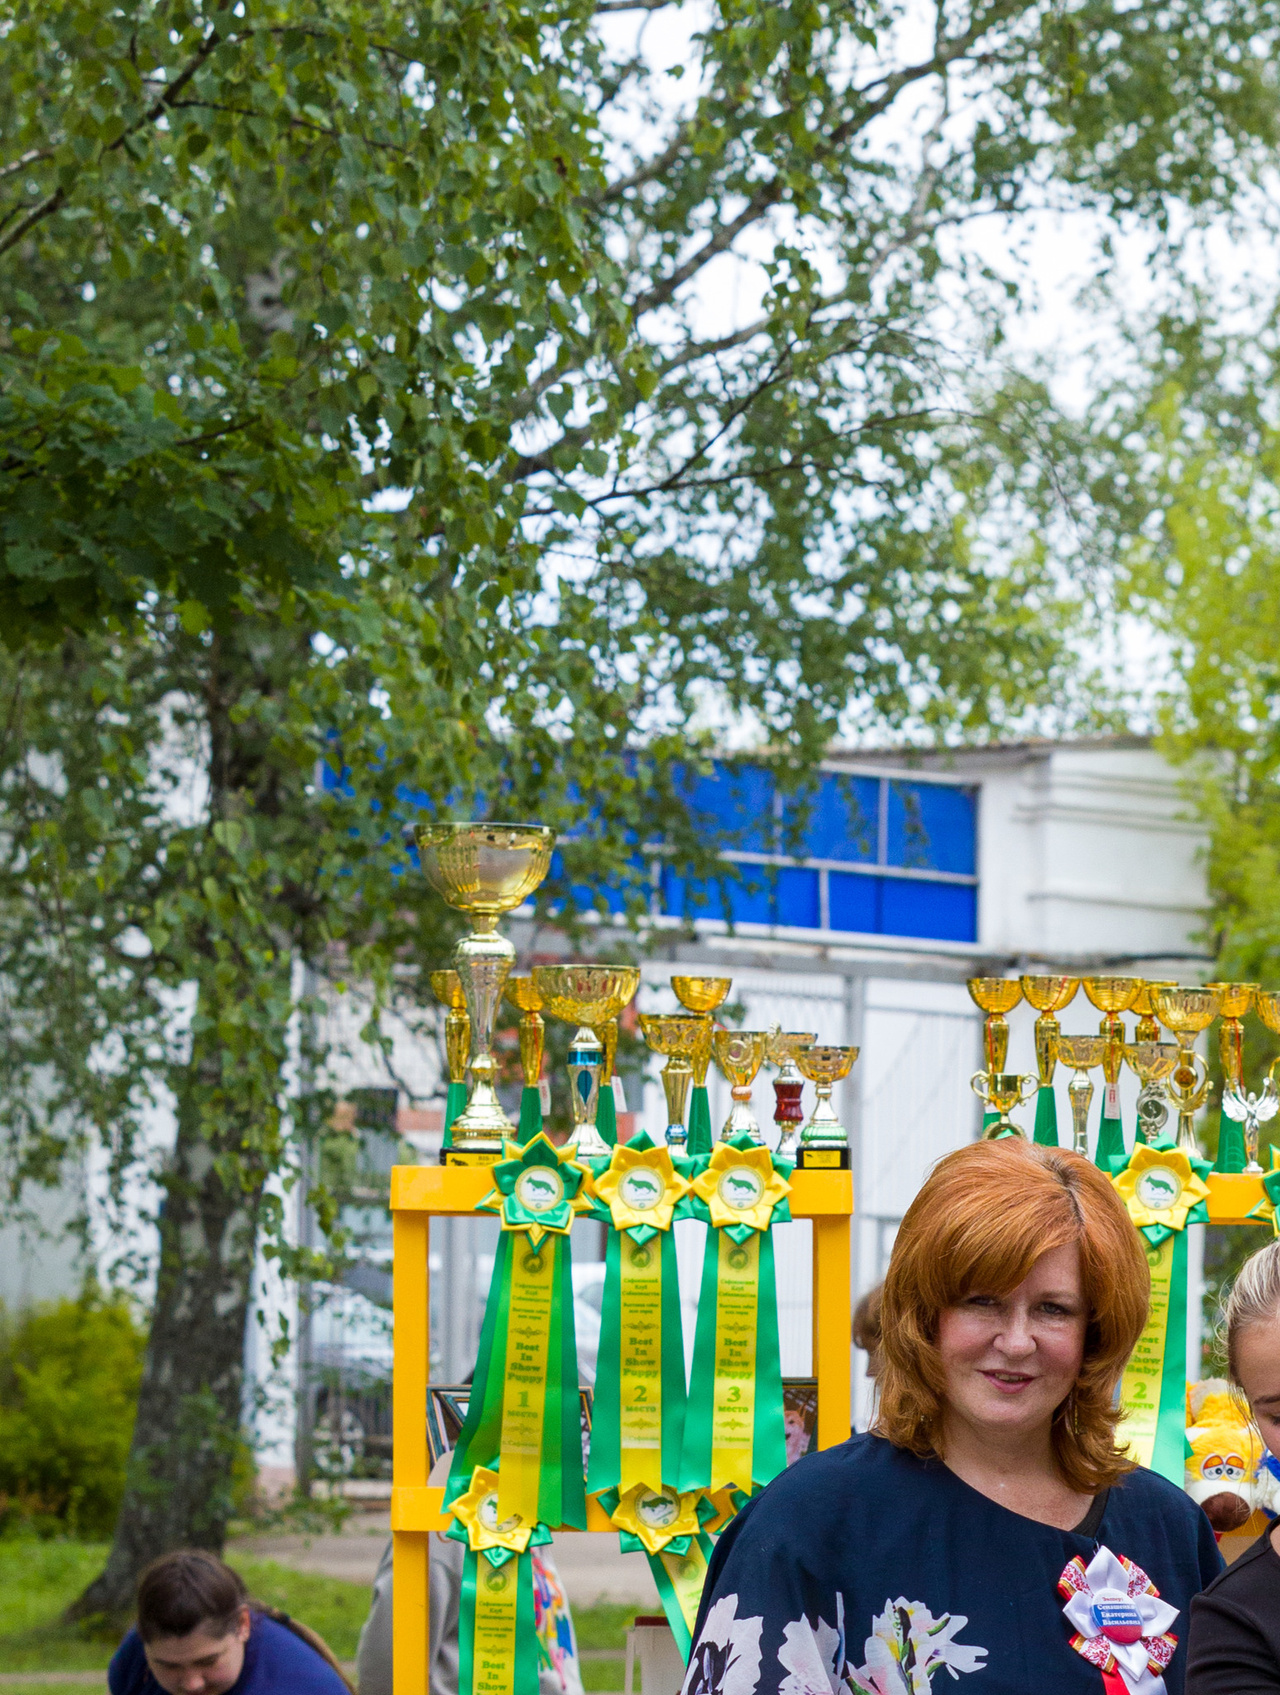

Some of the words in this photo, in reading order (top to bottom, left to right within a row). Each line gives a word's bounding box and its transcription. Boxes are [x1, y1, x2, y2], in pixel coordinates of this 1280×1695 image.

[515, 1342, 540, 1351] Best
[629, 1338, 653, 1346] Best
[724, 1338, 748, 1347] Best
[635, 1348, 648, 1356] In
[729, 1349, 742, 1357] In
[1137, 1345, 1152, 1354] In
[519, 1353, 533, 1361] In
[1130, 1355, 1161, 1365] how
[510, 1362, 541, 1372] Show
[625, 1358, 656, 1367] Show
[719, 1359, 750, 1368] Show
[507, 1371, 544, 1384] Puppy
[622, 1368, 659, 1379] Puppy
[716, 1368, 753, 1380] Puppy
[633, 1385, 648, 1402] 2
[726, 1386, 741, 1403] 3
[1132, 1382, 1148, 1400] 2
[517, 1391, 530, 1408] 1
[507, 1409, 539, 1419] место
[1100, 1611, 1138, 1619] Екатерина
[482, 1660, 506, 1670] Best
[487, 1671, 499, 1680] In
[477, 1681, 508, 1691] Show
